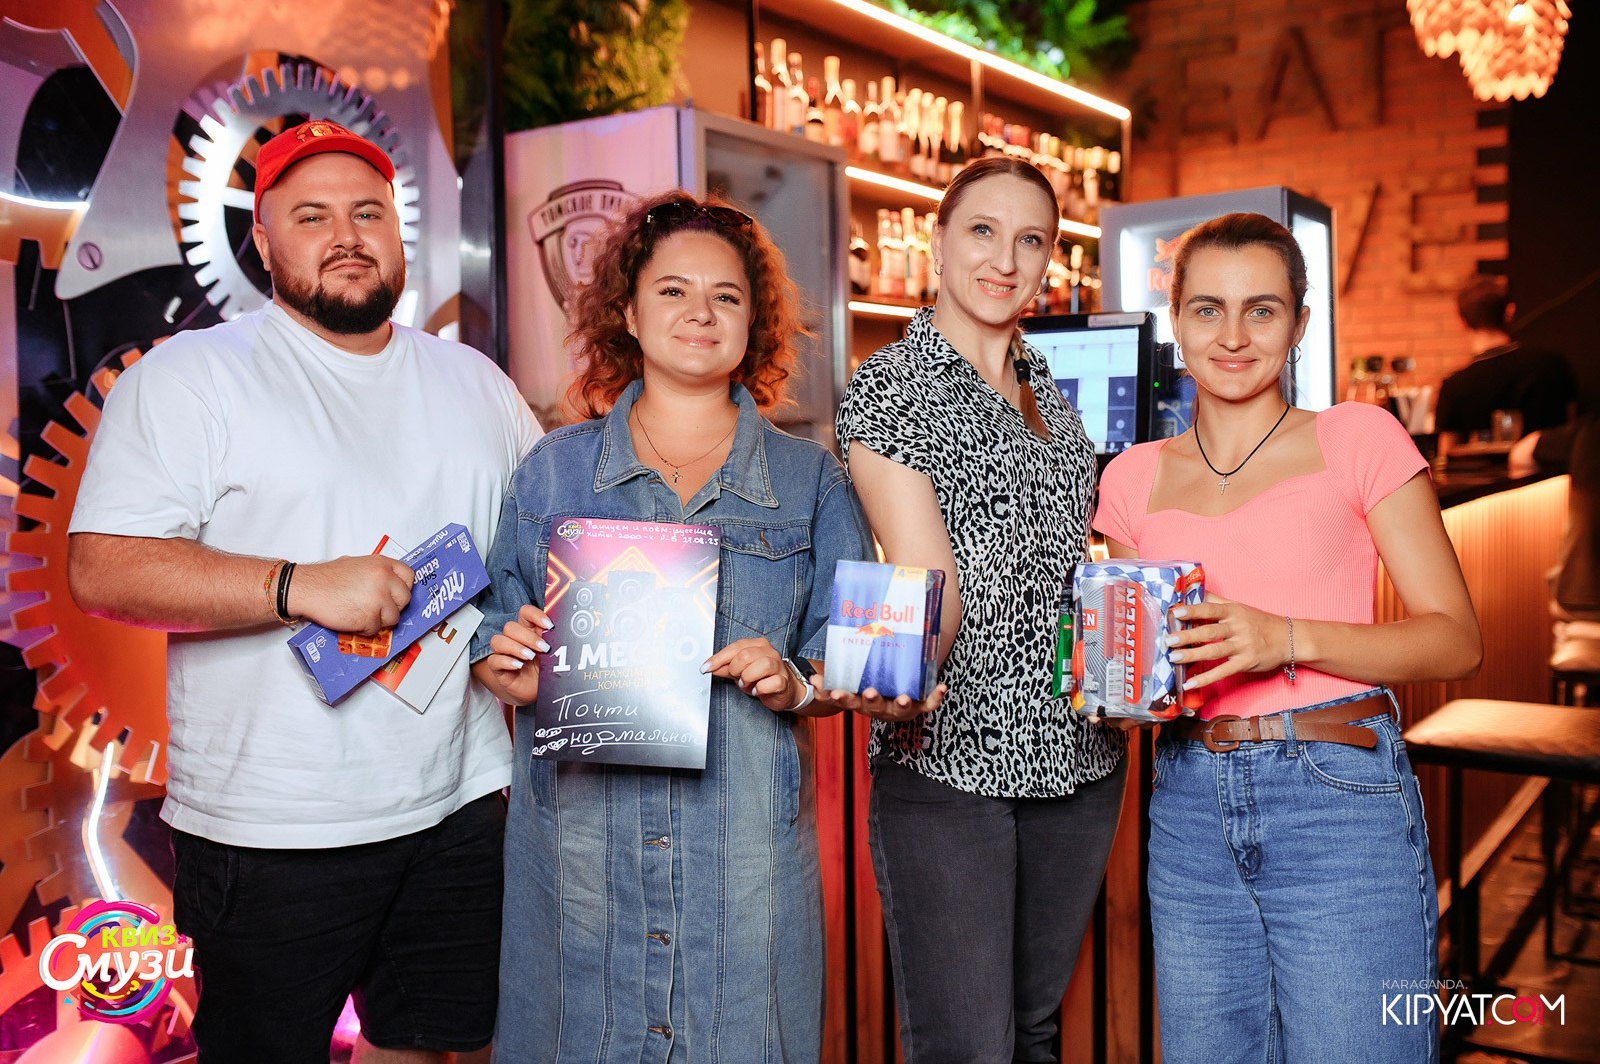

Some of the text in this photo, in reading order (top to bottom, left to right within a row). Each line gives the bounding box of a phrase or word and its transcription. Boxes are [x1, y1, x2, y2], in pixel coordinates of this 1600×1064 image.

[557, 525, 585, 540] Смузи
[421, 571, 465, 618] Milka
[841, 600, 915, 623] Red Bull
[842, 637, 876, 647] ENERGY
[552, 636, 700, 673] 1 МЕО
[597, 676, 651, 690] КОМАНД
[552, 689, 638, 722] Почти
[1162, 694, 1177, 706] 4x
[571, 729, 703, 755] нормальны
